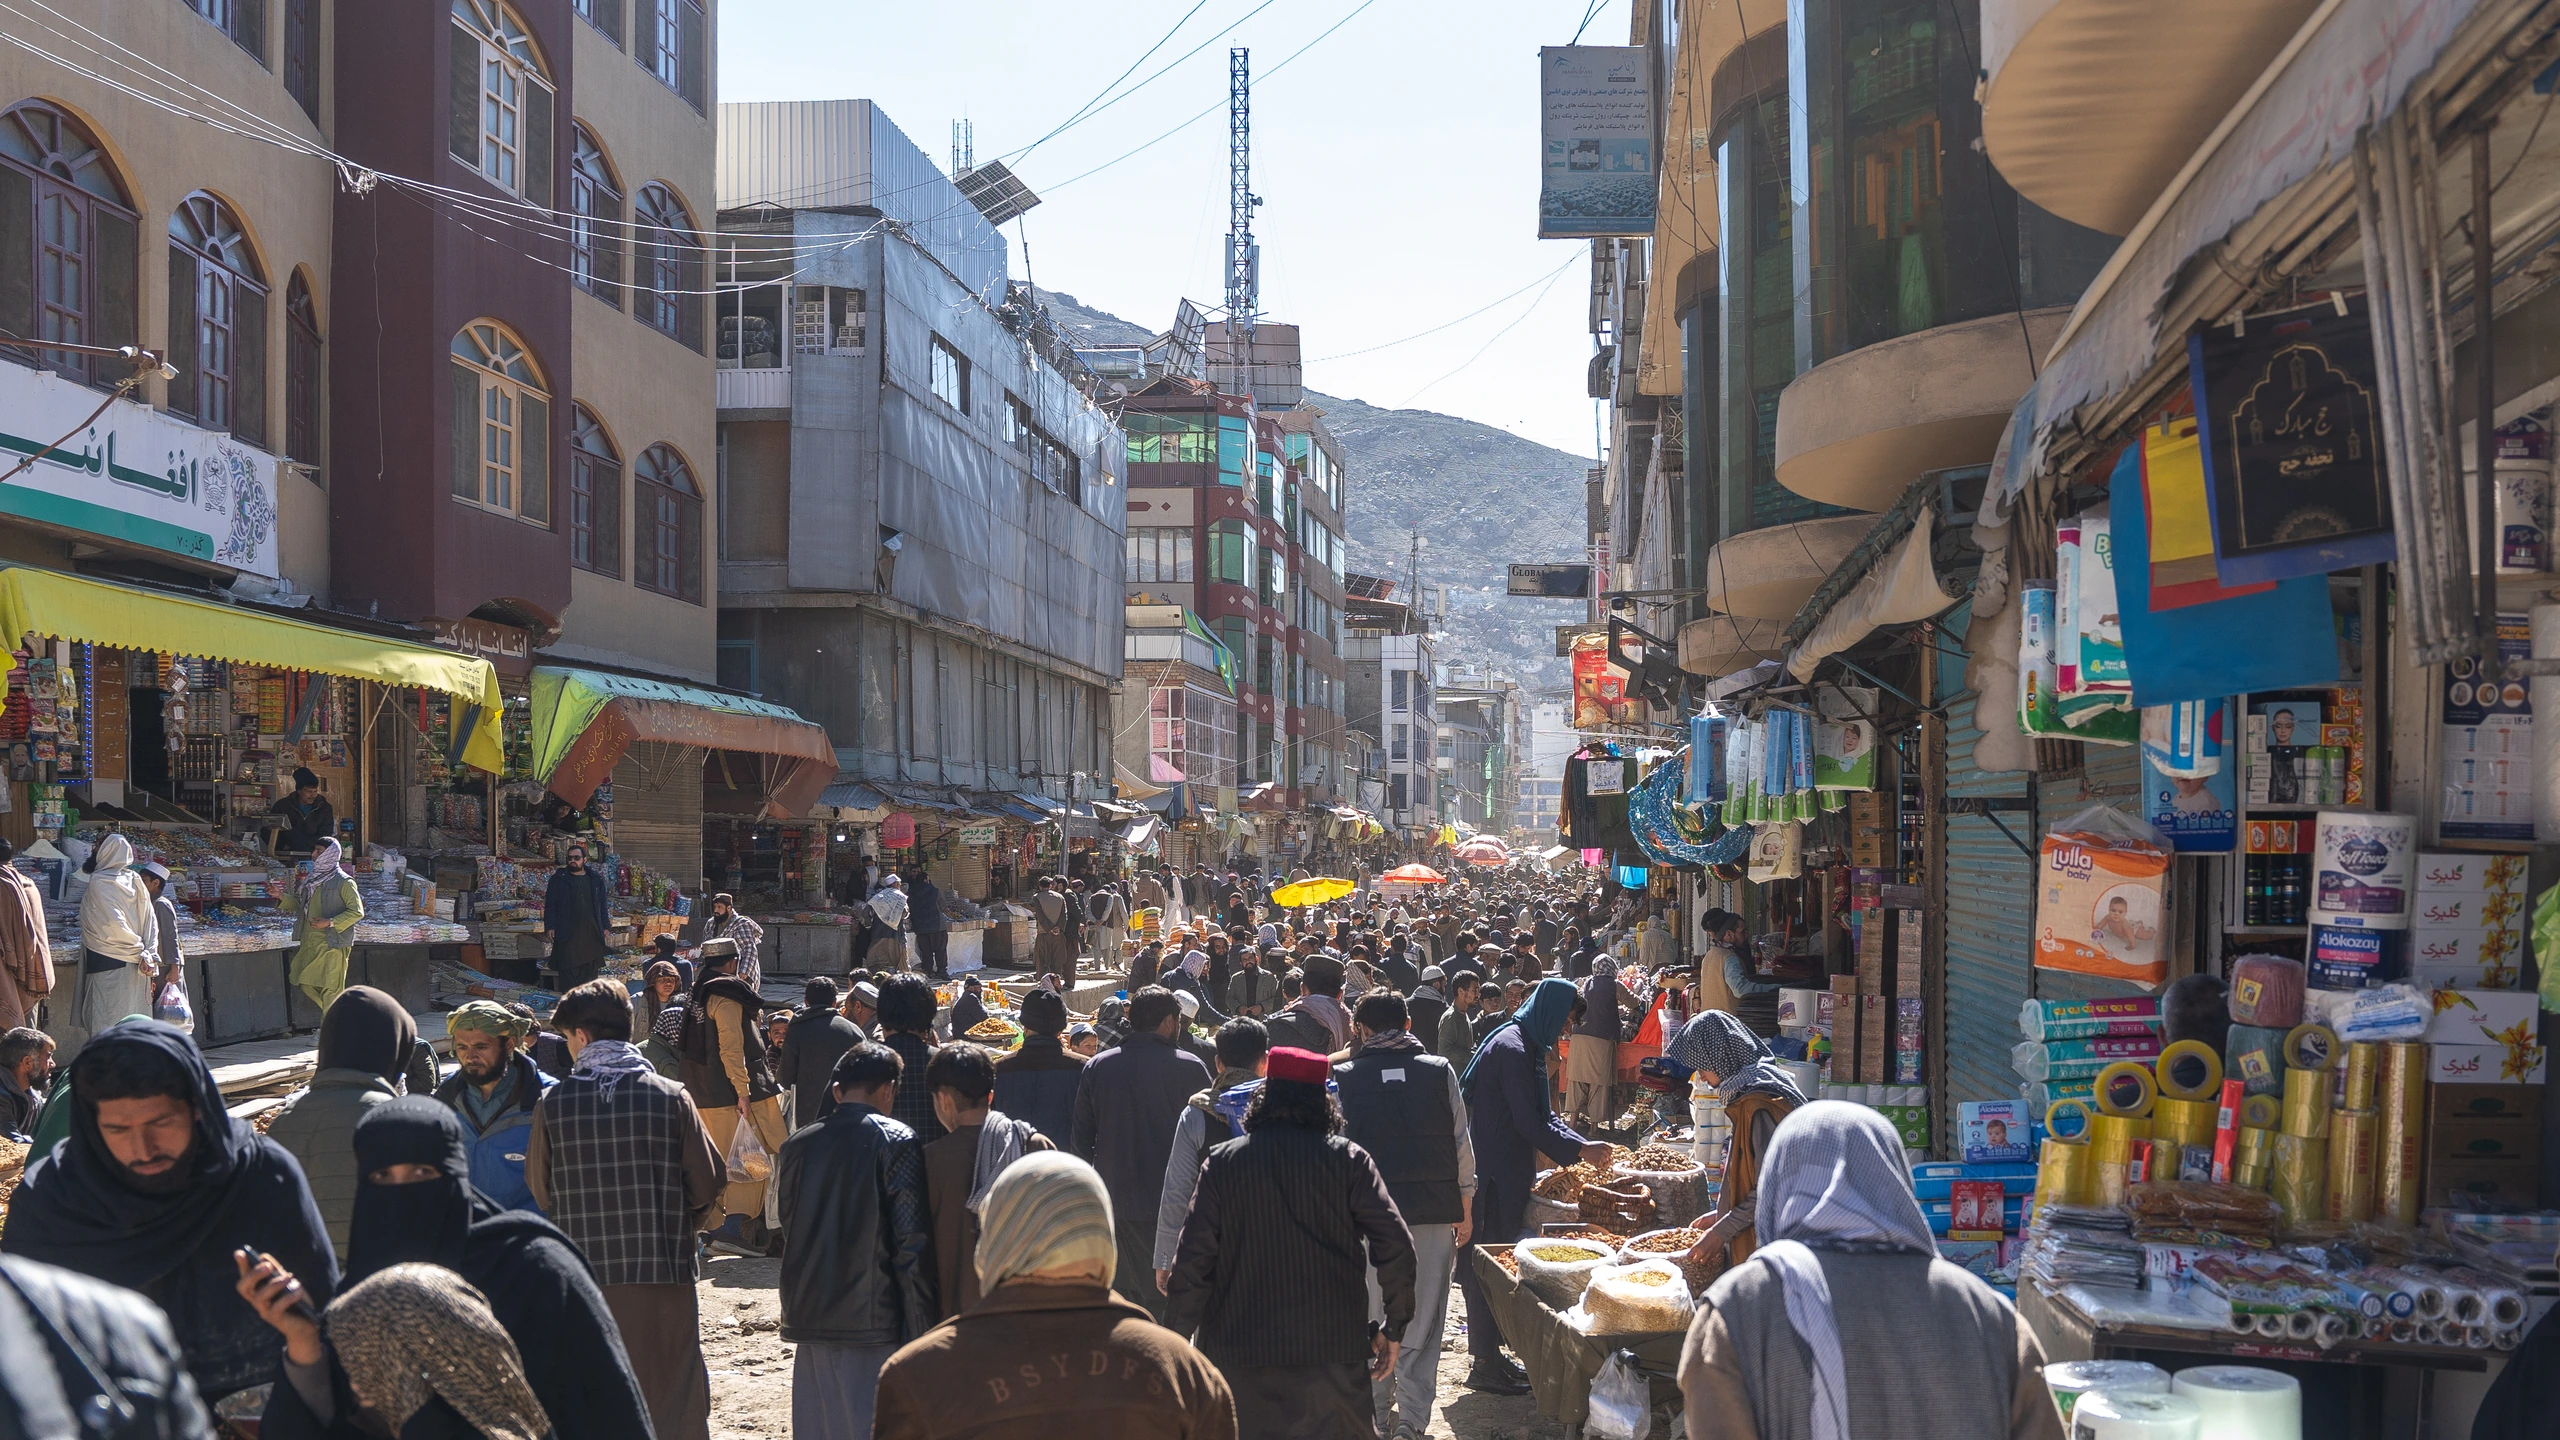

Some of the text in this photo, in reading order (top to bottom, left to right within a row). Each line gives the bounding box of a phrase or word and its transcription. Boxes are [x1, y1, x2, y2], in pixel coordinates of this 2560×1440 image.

[1546, 88, 1560, 96] اباسین
[1572, 88, 1587, 96] تجارتی
[1593, 88, 1607, 96] صنعتی
[1608, 88, 1617, 96] های
[1618, 88, 1633, 96] شرکت
[2275, 391, 2313, 439] مبارک
[2279, 449, 2334, 475] تحفه حج
[2090, 659, 2101, 674] 4
[2161, 792, 2169, 801] 4
[2161, 814, 2171, 822] 60
[960, 827, 980, 835] فروشی
[2051, 847, 2093, 870] Lulla
[2338, 850, 2391, 865] Soft Touch
[2066, 868, 2092, 882] baby
[2044, 926, 2053, 941] 3
[2319, 933, 2380, 953] Alokozay
[2355, 998, 2381, 1008] PLASTIC
[1979, 1105, 2012, 1114] Alokozay
